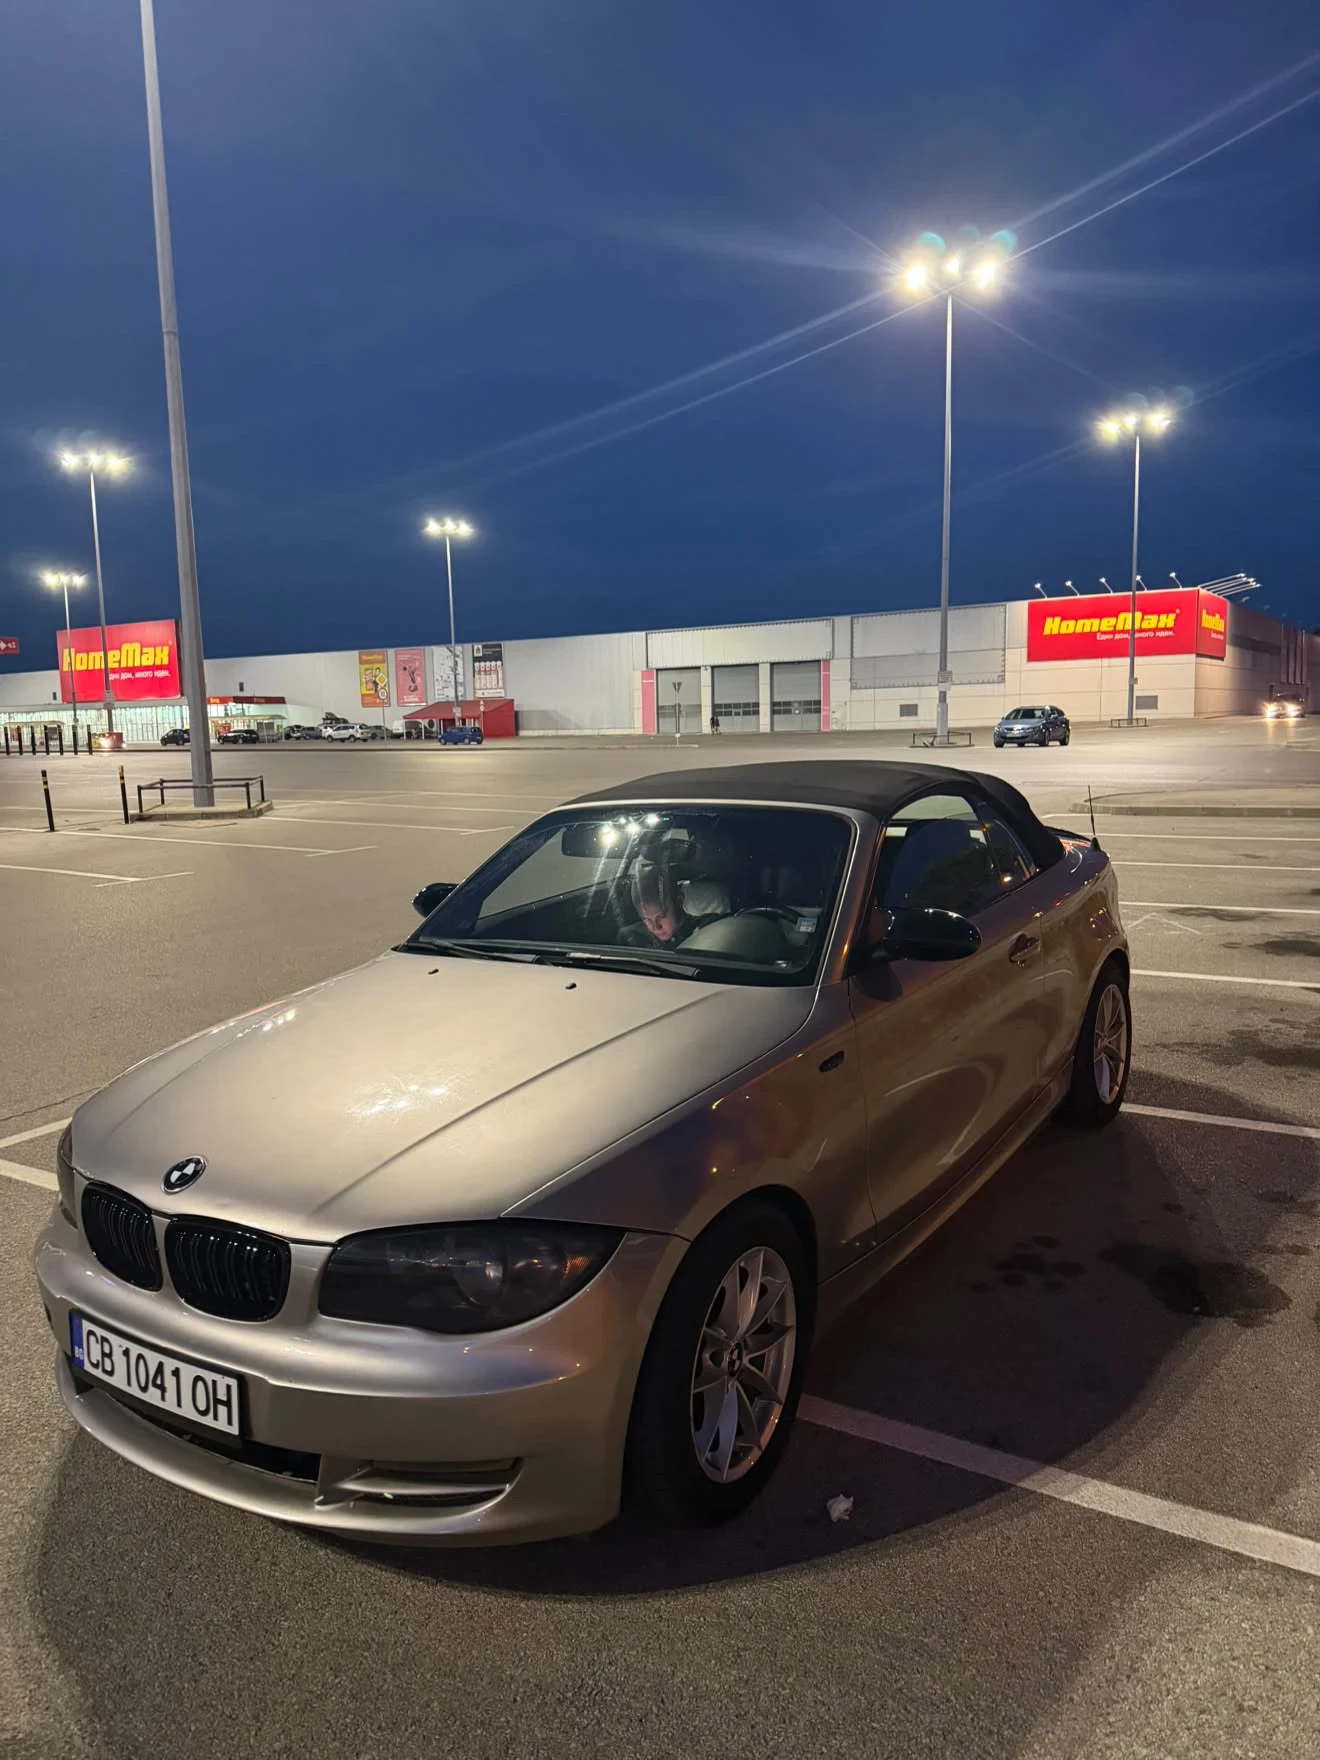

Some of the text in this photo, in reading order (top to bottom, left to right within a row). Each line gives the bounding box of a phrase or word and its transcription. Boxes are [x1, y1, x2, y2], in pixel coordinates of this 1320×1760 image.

[1043, 611, 1176, 635] HomeMax
[62, 642, 169, 672] HomeMax
[86, 1329, 233, 1426] CB 1041 OH
